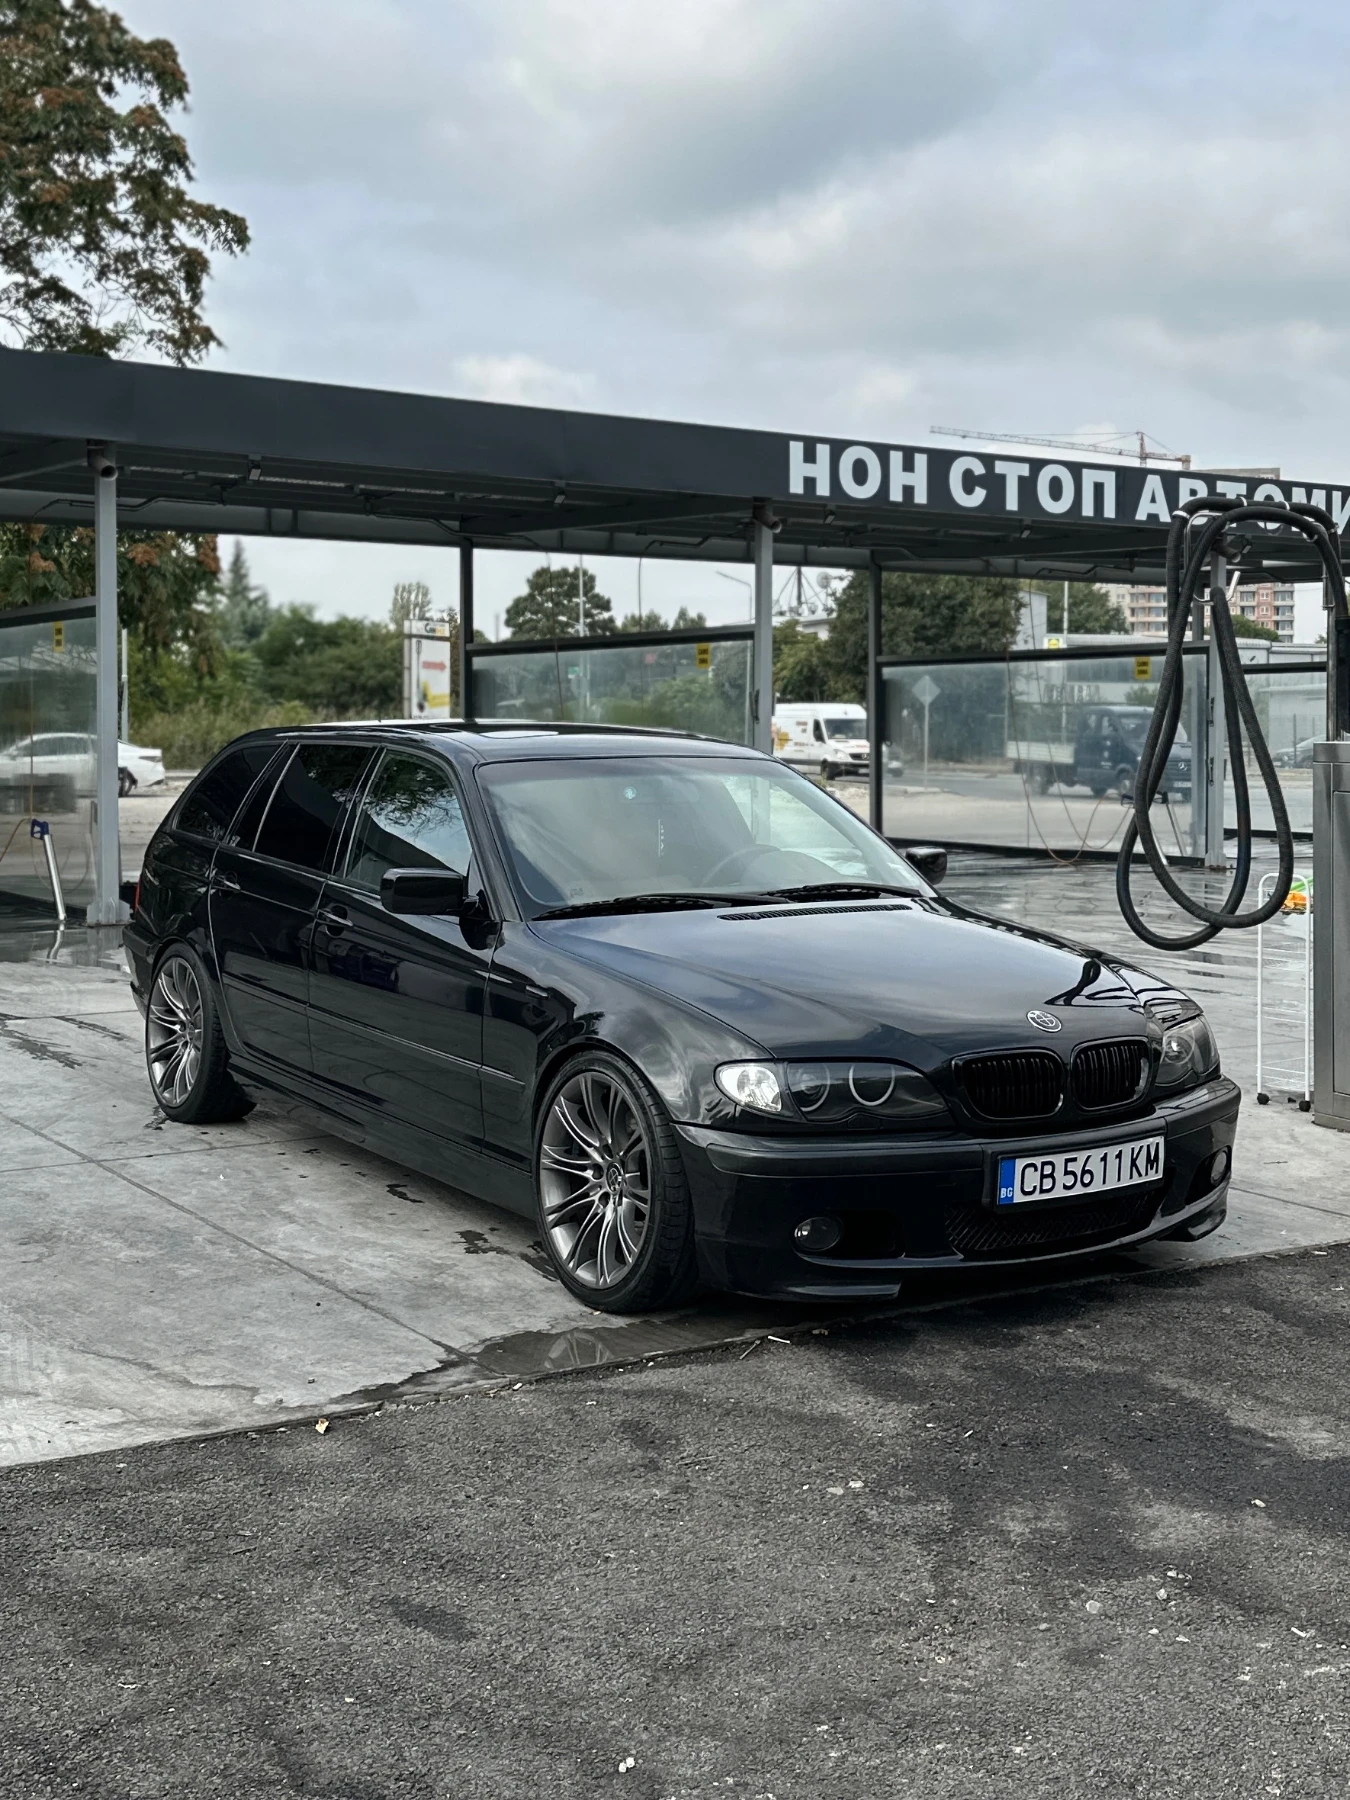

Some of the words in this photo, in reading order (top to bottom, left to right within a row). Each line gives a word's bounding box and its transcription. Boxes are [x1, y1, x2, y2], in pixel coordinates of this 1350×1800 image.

[789, 440, 928, 505] НОН
[949, 456, 1116, 519] СТОП
[1000, 1187, 1013, 1198] BG
